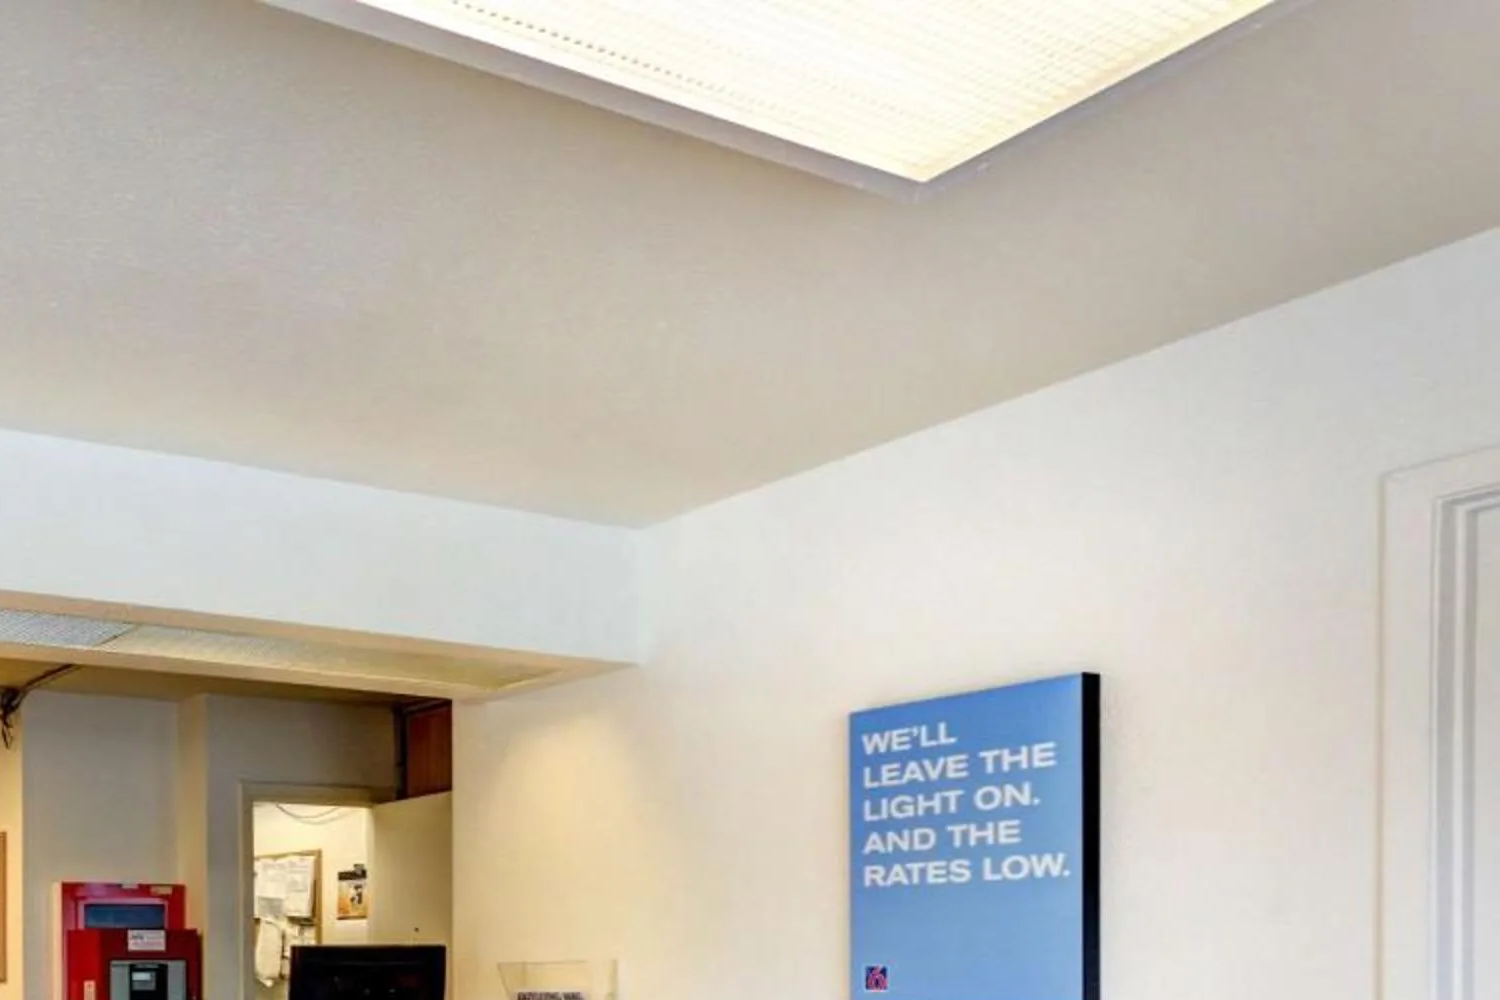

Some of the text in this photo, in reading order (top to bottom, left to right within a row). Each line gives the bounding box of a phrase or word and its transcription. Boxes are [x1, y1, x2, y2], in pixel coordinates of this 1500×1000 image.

[861, 721, 958, 755] WE'LL
[863, 741, 1058, 790] LEAVE THE
[863, 781, 1041, 822] LIGHT ON.
[863, 818, 1023, 856] AND THE
[863, 851, 1071, 888] RATES LOW.
